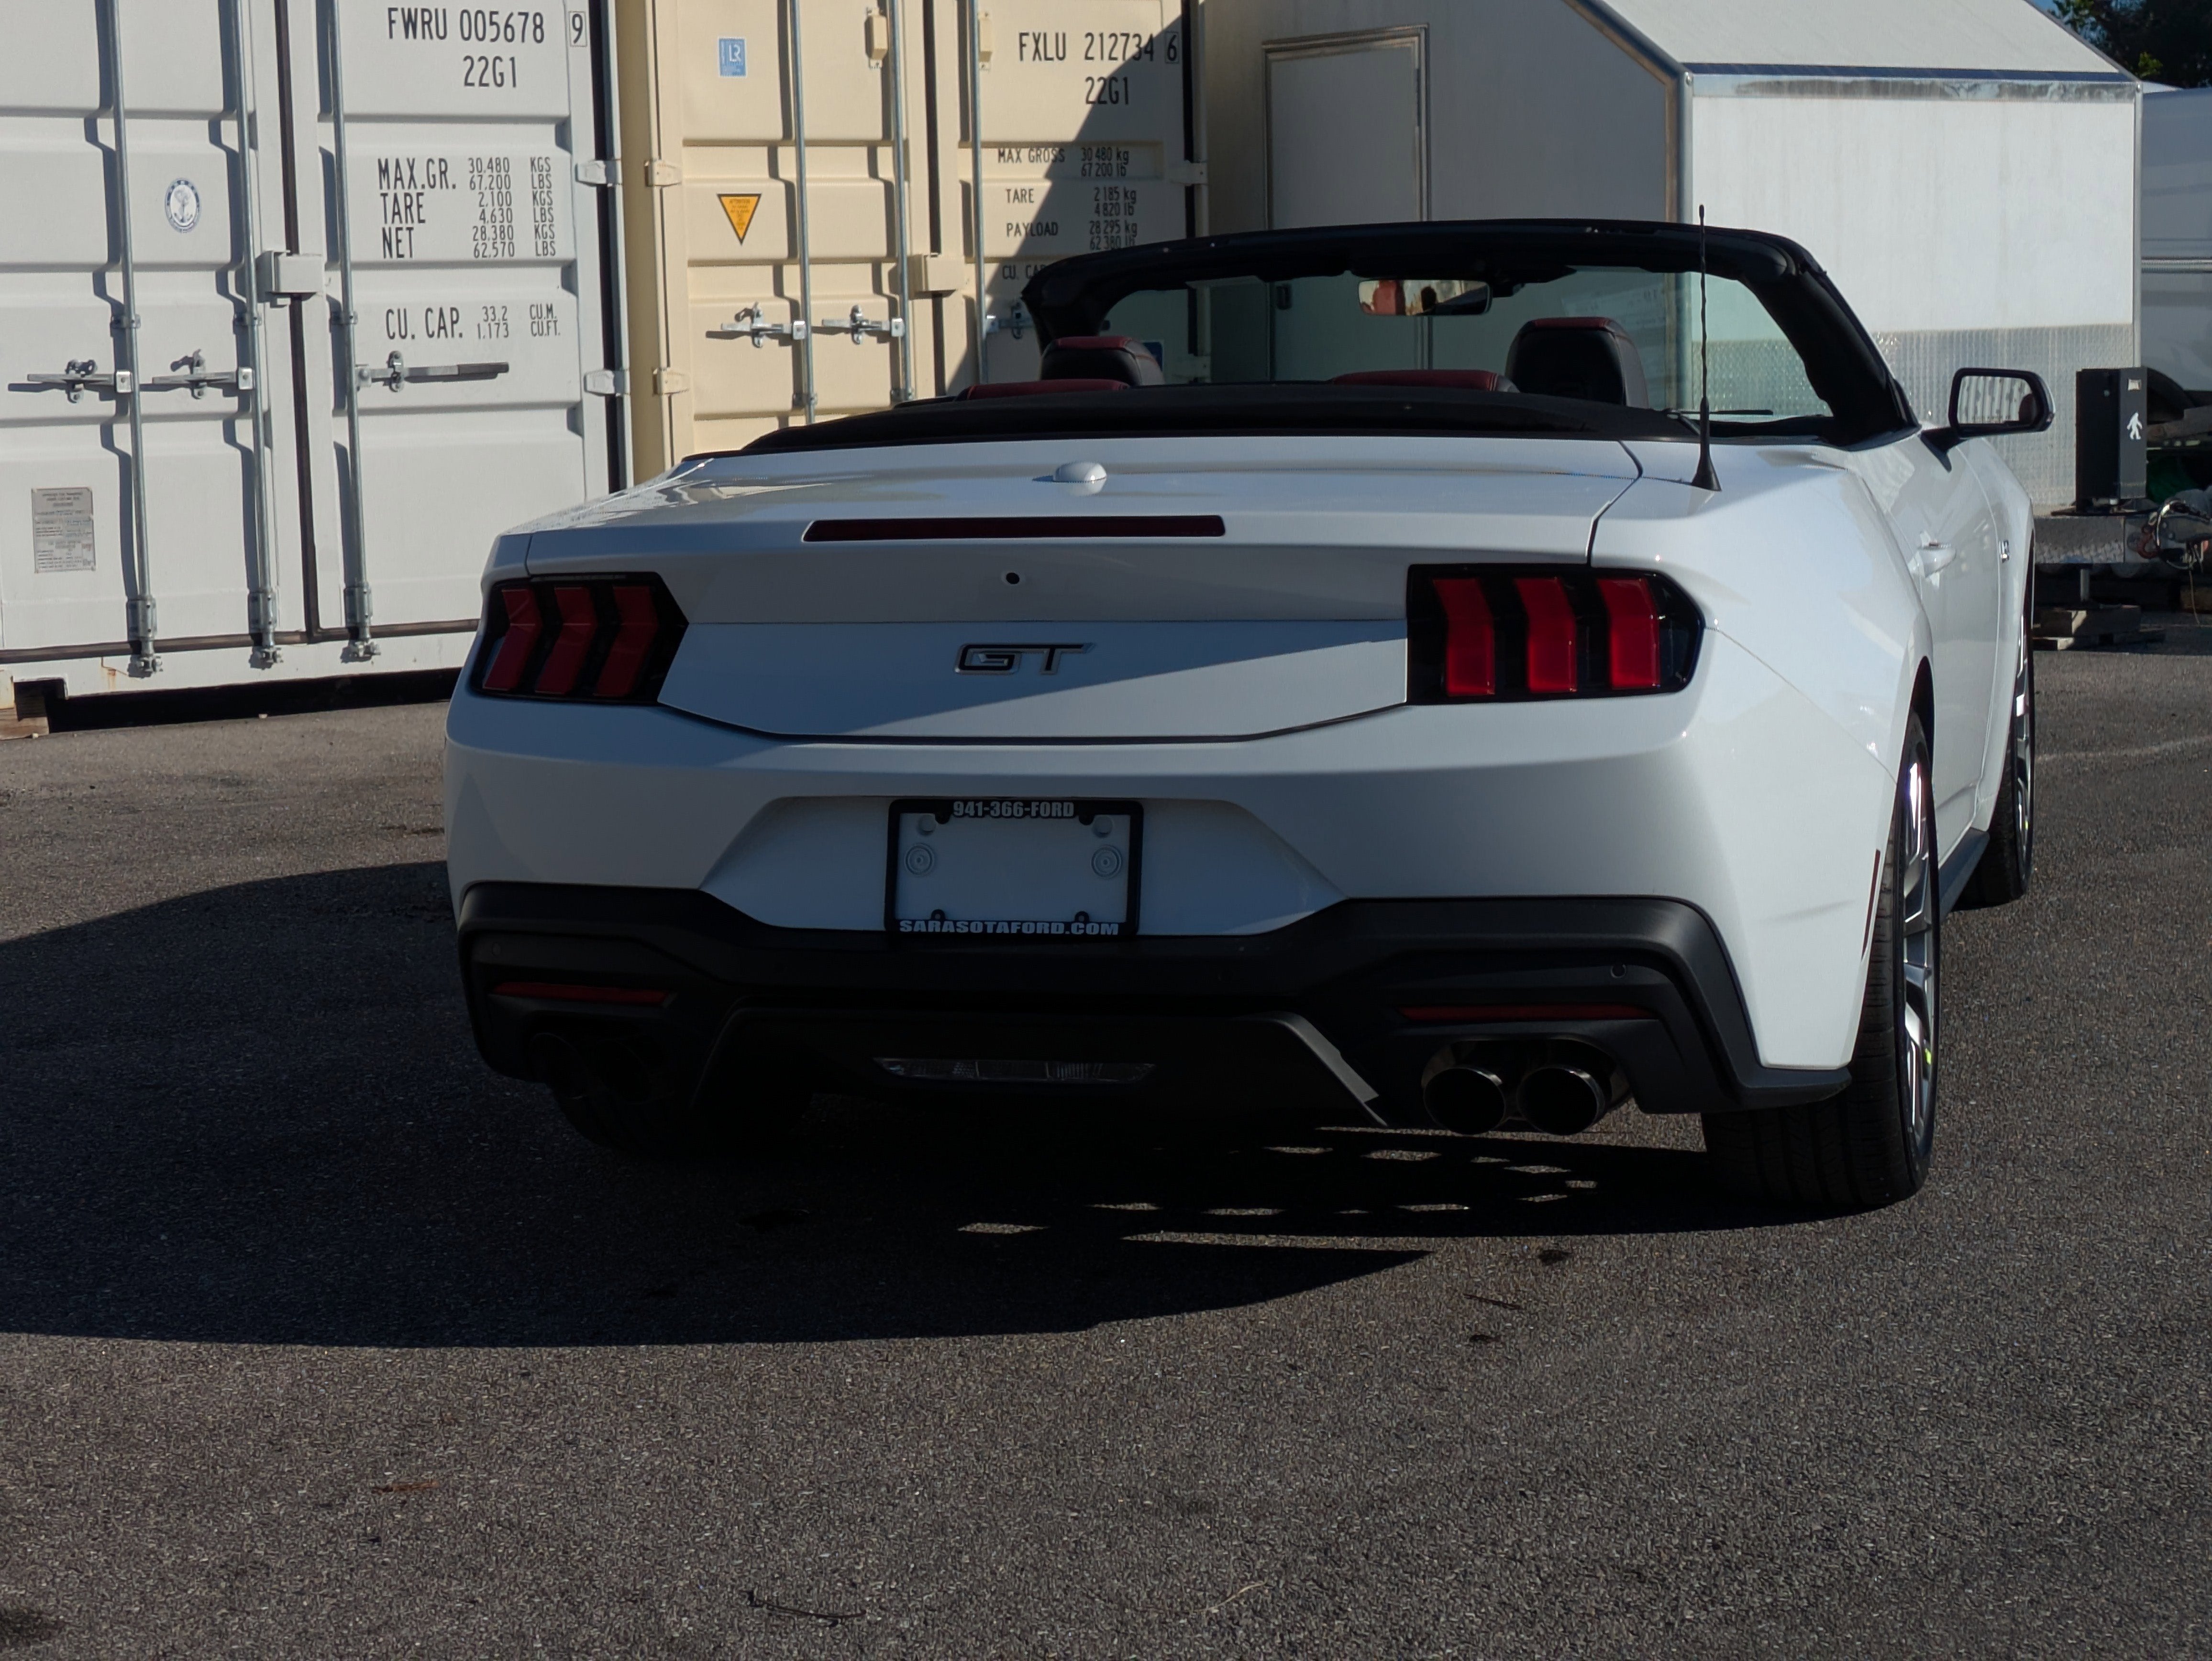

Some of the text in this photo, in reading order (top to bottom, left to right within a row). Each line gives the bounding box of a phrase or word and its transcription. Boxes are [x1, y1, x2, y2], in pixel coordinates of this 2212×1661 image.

[387, 7, 583, 44] FWRU 005678 9
[1019, 32, 1177, 62] FXLU 212734 6
[463, 55, 517, 88] 22G1
[1085, 76, 1129, 105] 22G1
[530, 156, 551, 172] KGS
[998, 147, 1065, 164] MAX GROSS
[1116, 147, 1129, 165] kg
[378, 158, 457, 190] MAX.GR.
[531, 173, 552, 189] LBS
[532, 190, 553, 206] KGS
[1006, 188, 1035, 204] TARE
[1123, 186, 1137, 204] kg
[380, 192, 426, 224] TARE
[533, 207, 554, 223] LBS
[534, 224, 555, 240] KGS
[1006, 221, 1059, 237] PAYLOAD
[1125, 220, 1137, 237] kg
[382, 227, 414, 258] NET
[535, 241, 556, 256] LBS
[386, 307, 463, 340] CU. CAP.
[954, 642, 1096, 675] GT
[952, 801, 1074, 818] 941-366-FORD
[899, 919, 1119, 936] SARASOTAFORD.COM
